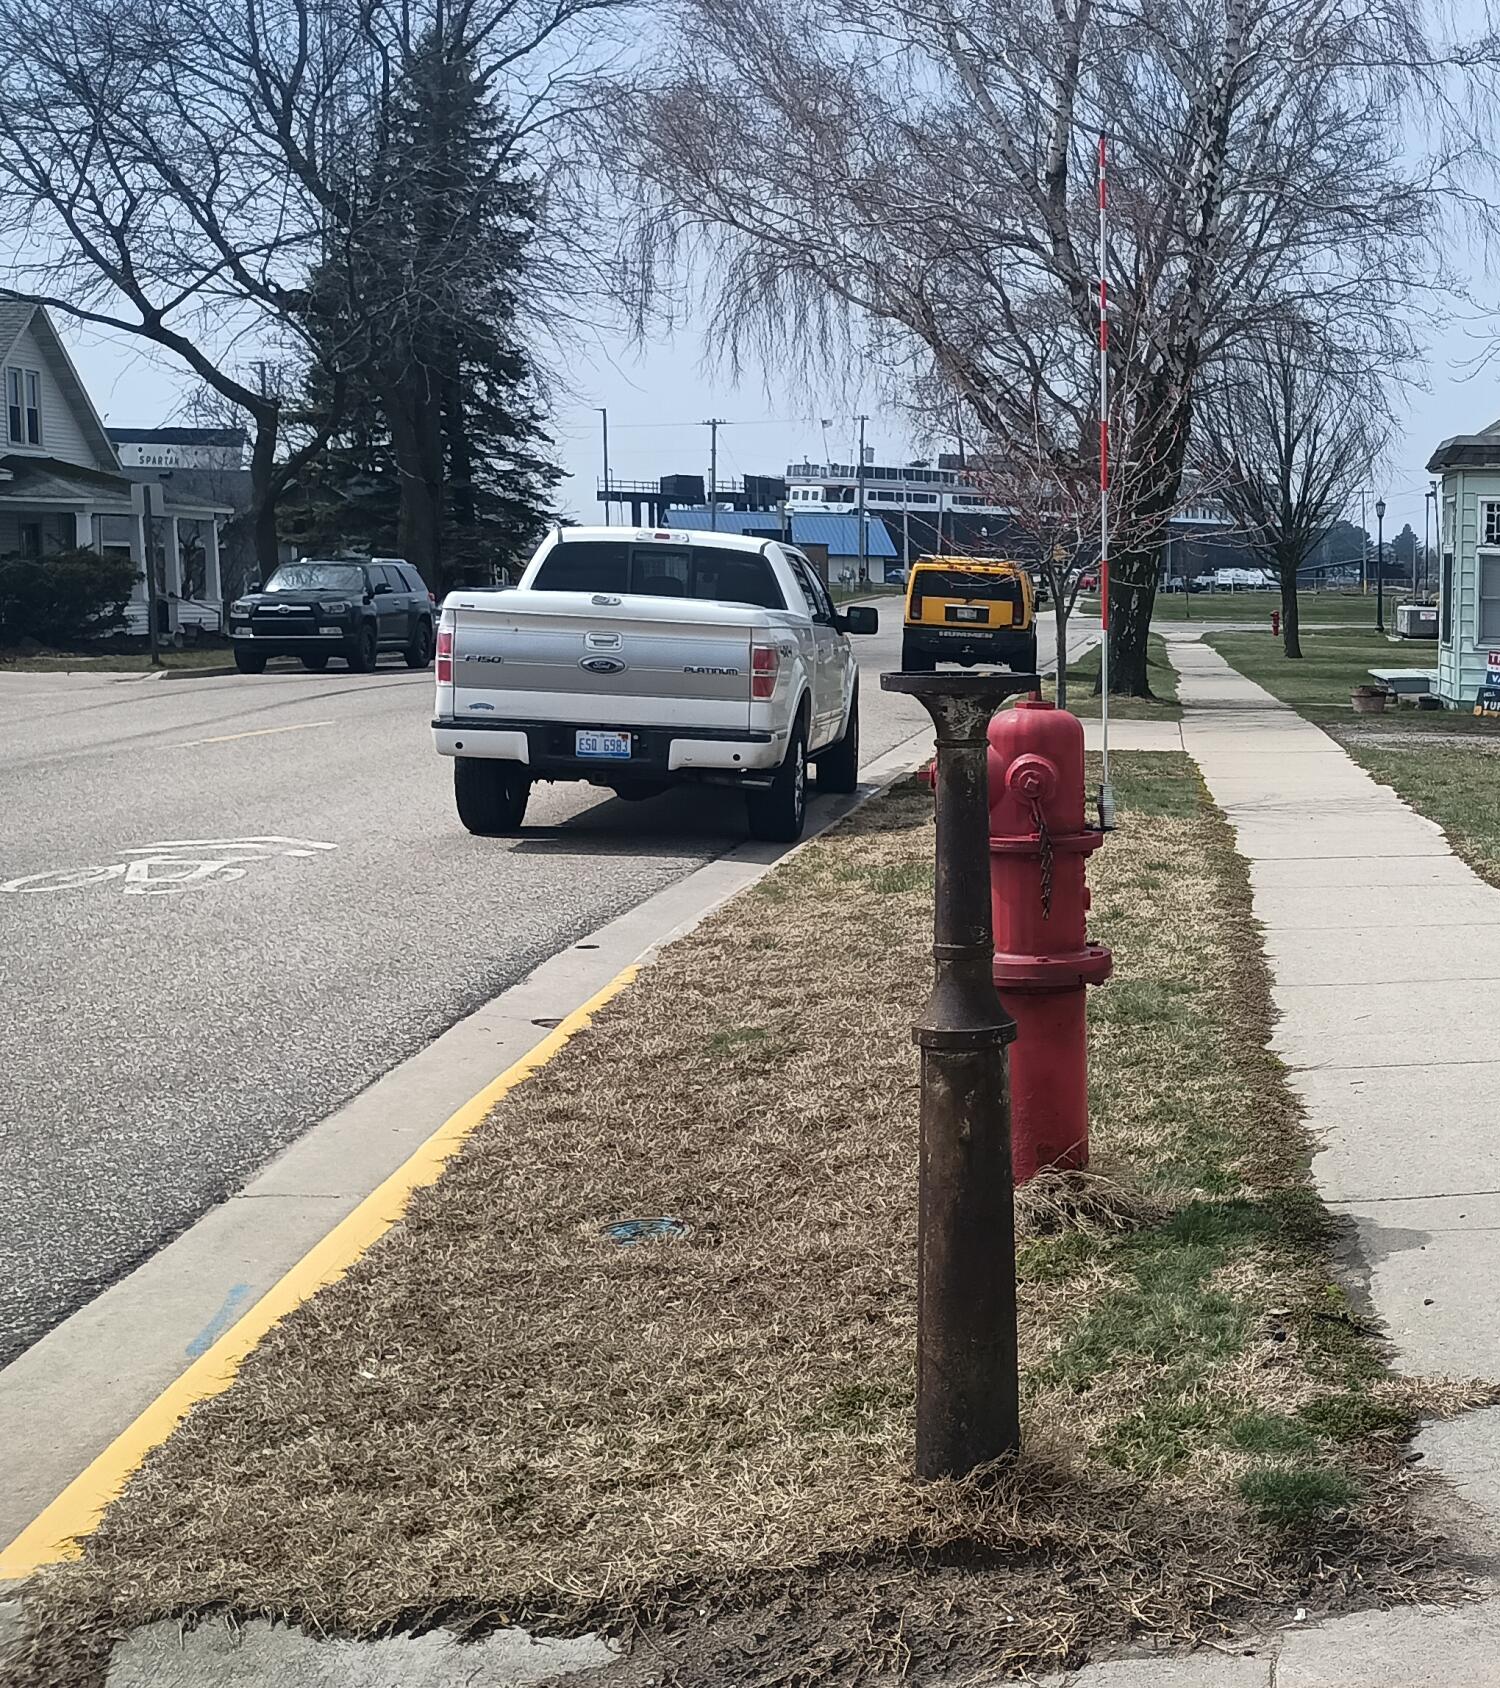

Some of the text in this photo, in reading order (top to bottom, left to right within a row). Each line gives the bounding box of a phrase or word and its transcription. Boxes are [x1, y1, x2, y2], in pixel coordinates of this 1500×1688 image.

[139, 455, 179, 465] SPARTAN
[938, 631, 994, 639] HUMMER
[683, 666, 739, 676] PLATINUM
[604, 739, 628, 752] 6983
